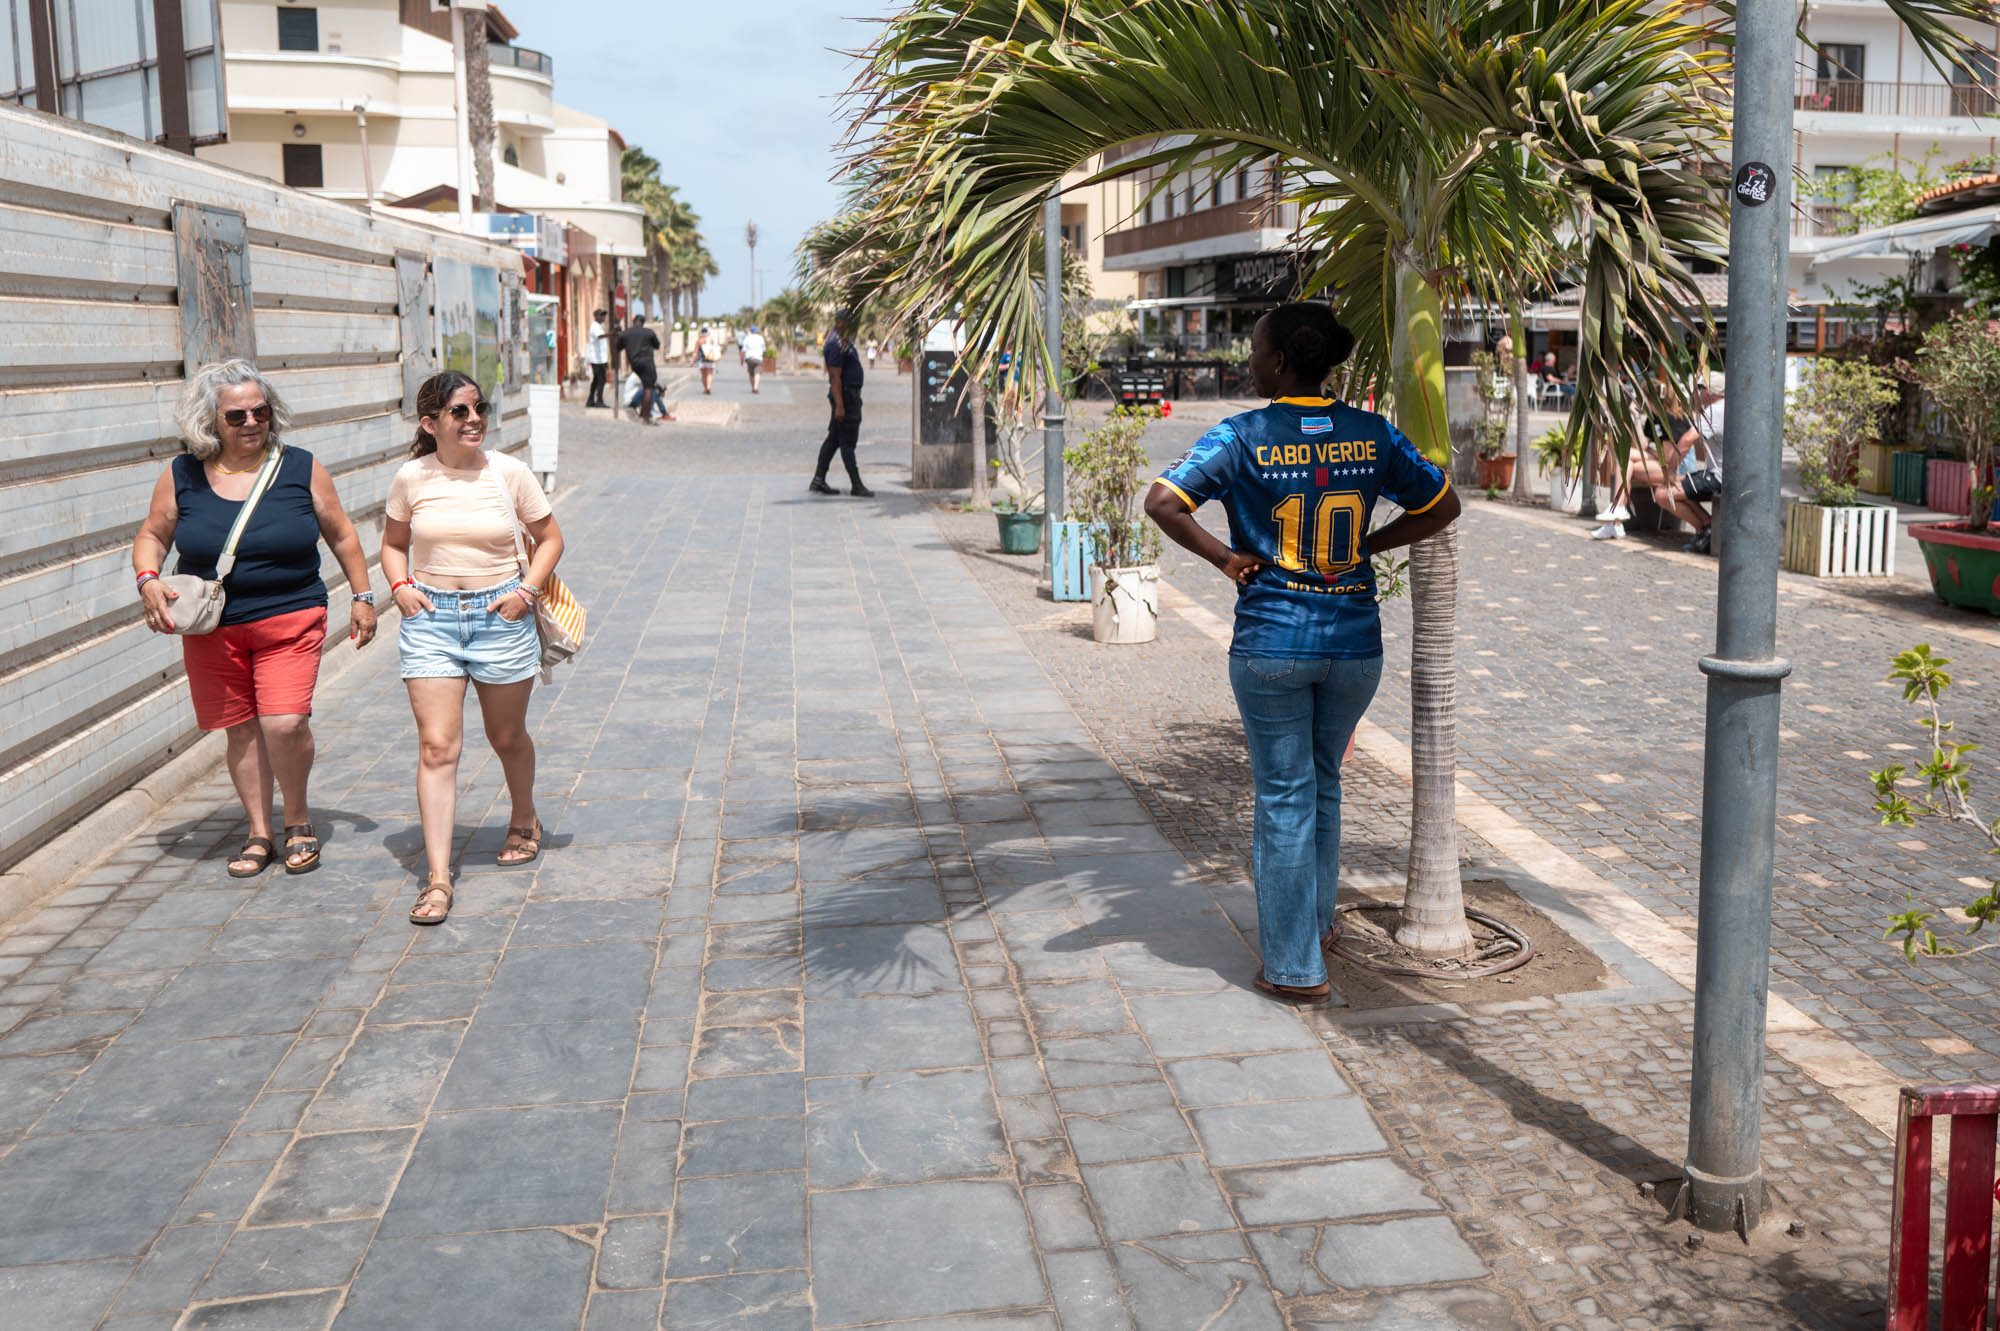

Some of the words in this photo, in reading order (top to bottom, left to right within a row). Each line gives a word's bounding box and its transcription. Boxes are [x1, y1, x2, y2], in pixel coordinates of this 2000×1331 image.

[1256, 444, 1311, 466] CABO
[1315, 440, 1377, 463] VERDE
[1271, 489, 1366, 576] 10
